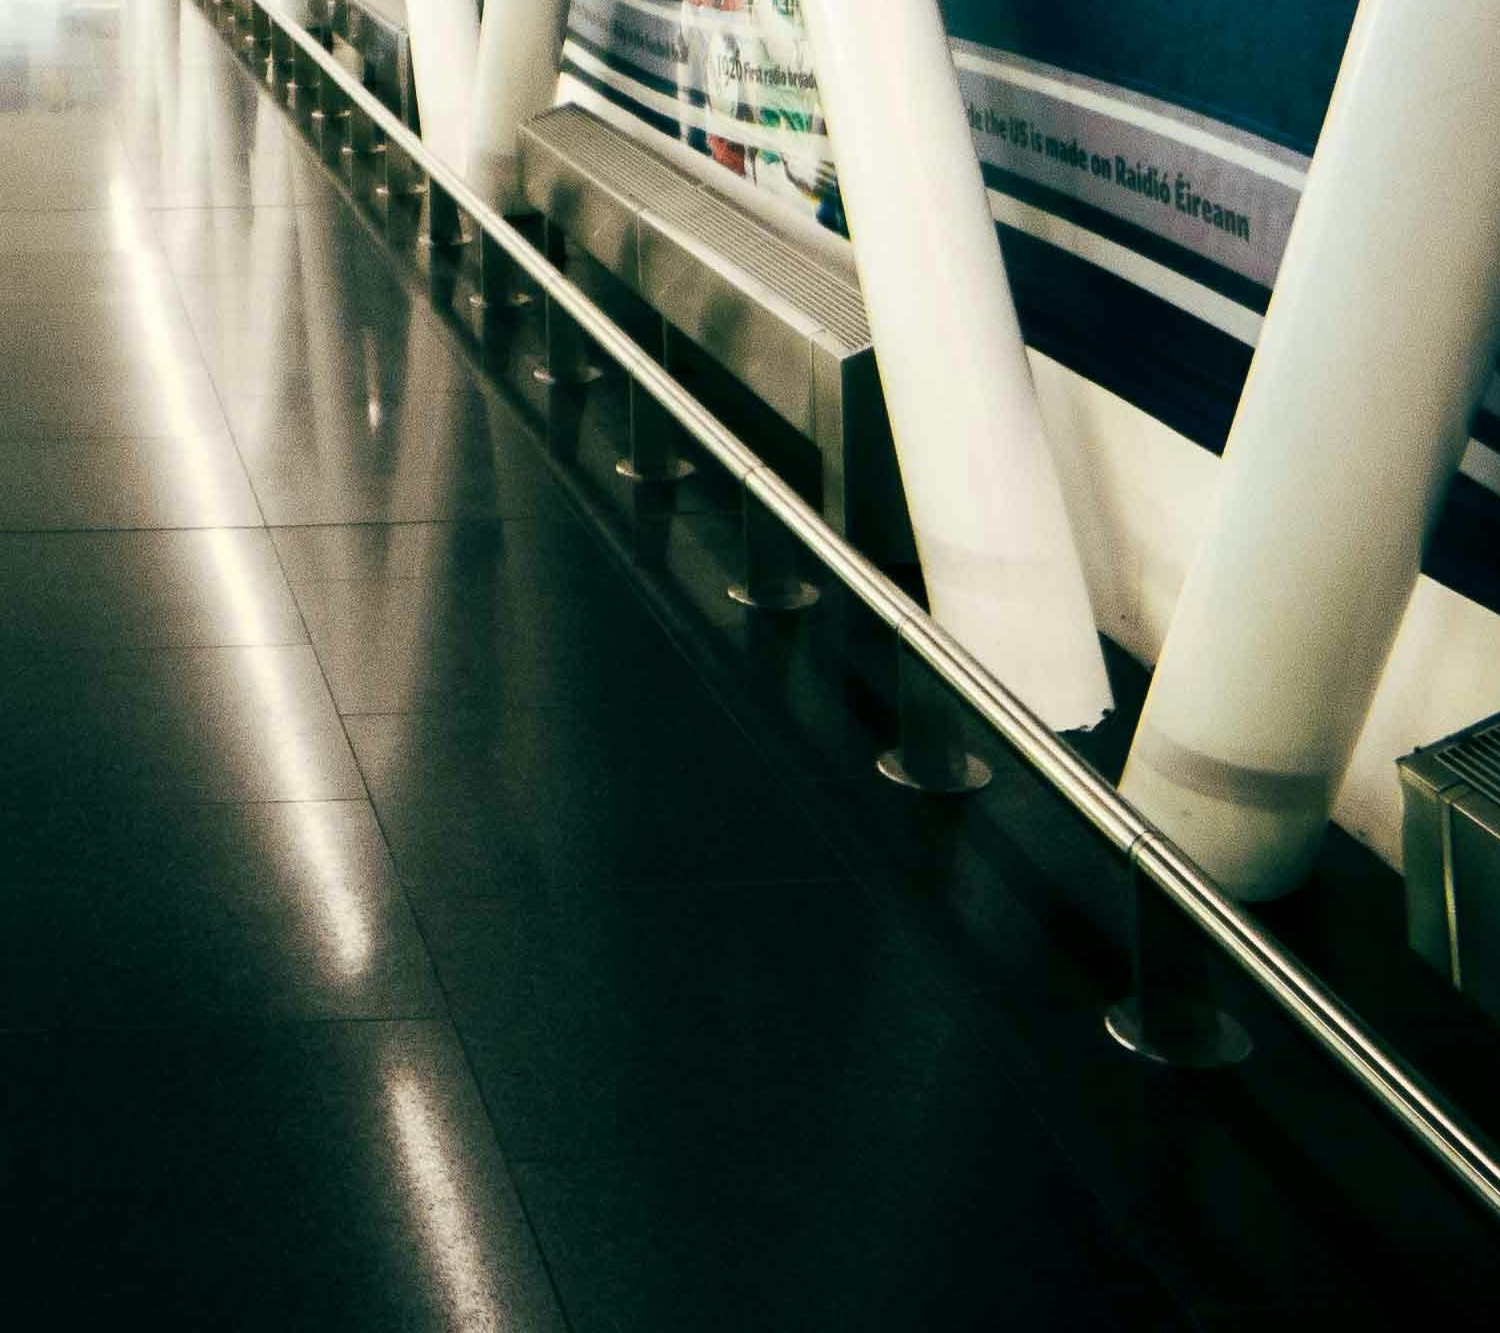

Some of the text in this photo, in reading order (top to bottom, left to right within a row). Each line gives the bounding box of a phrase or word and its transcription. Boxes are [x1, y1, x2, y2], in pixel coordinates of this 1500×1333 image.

[984, 107, 1006, 141] the
[1008, 116, 1028, 148] US
[1030, 121, 1042, 152] is
[1045, 137, 1088, 171] made
[1090, 153, 1112, 181] on
[1115, 155, 1170, 205] Raidió
[1174, 171, 1250, 242] Éireann
